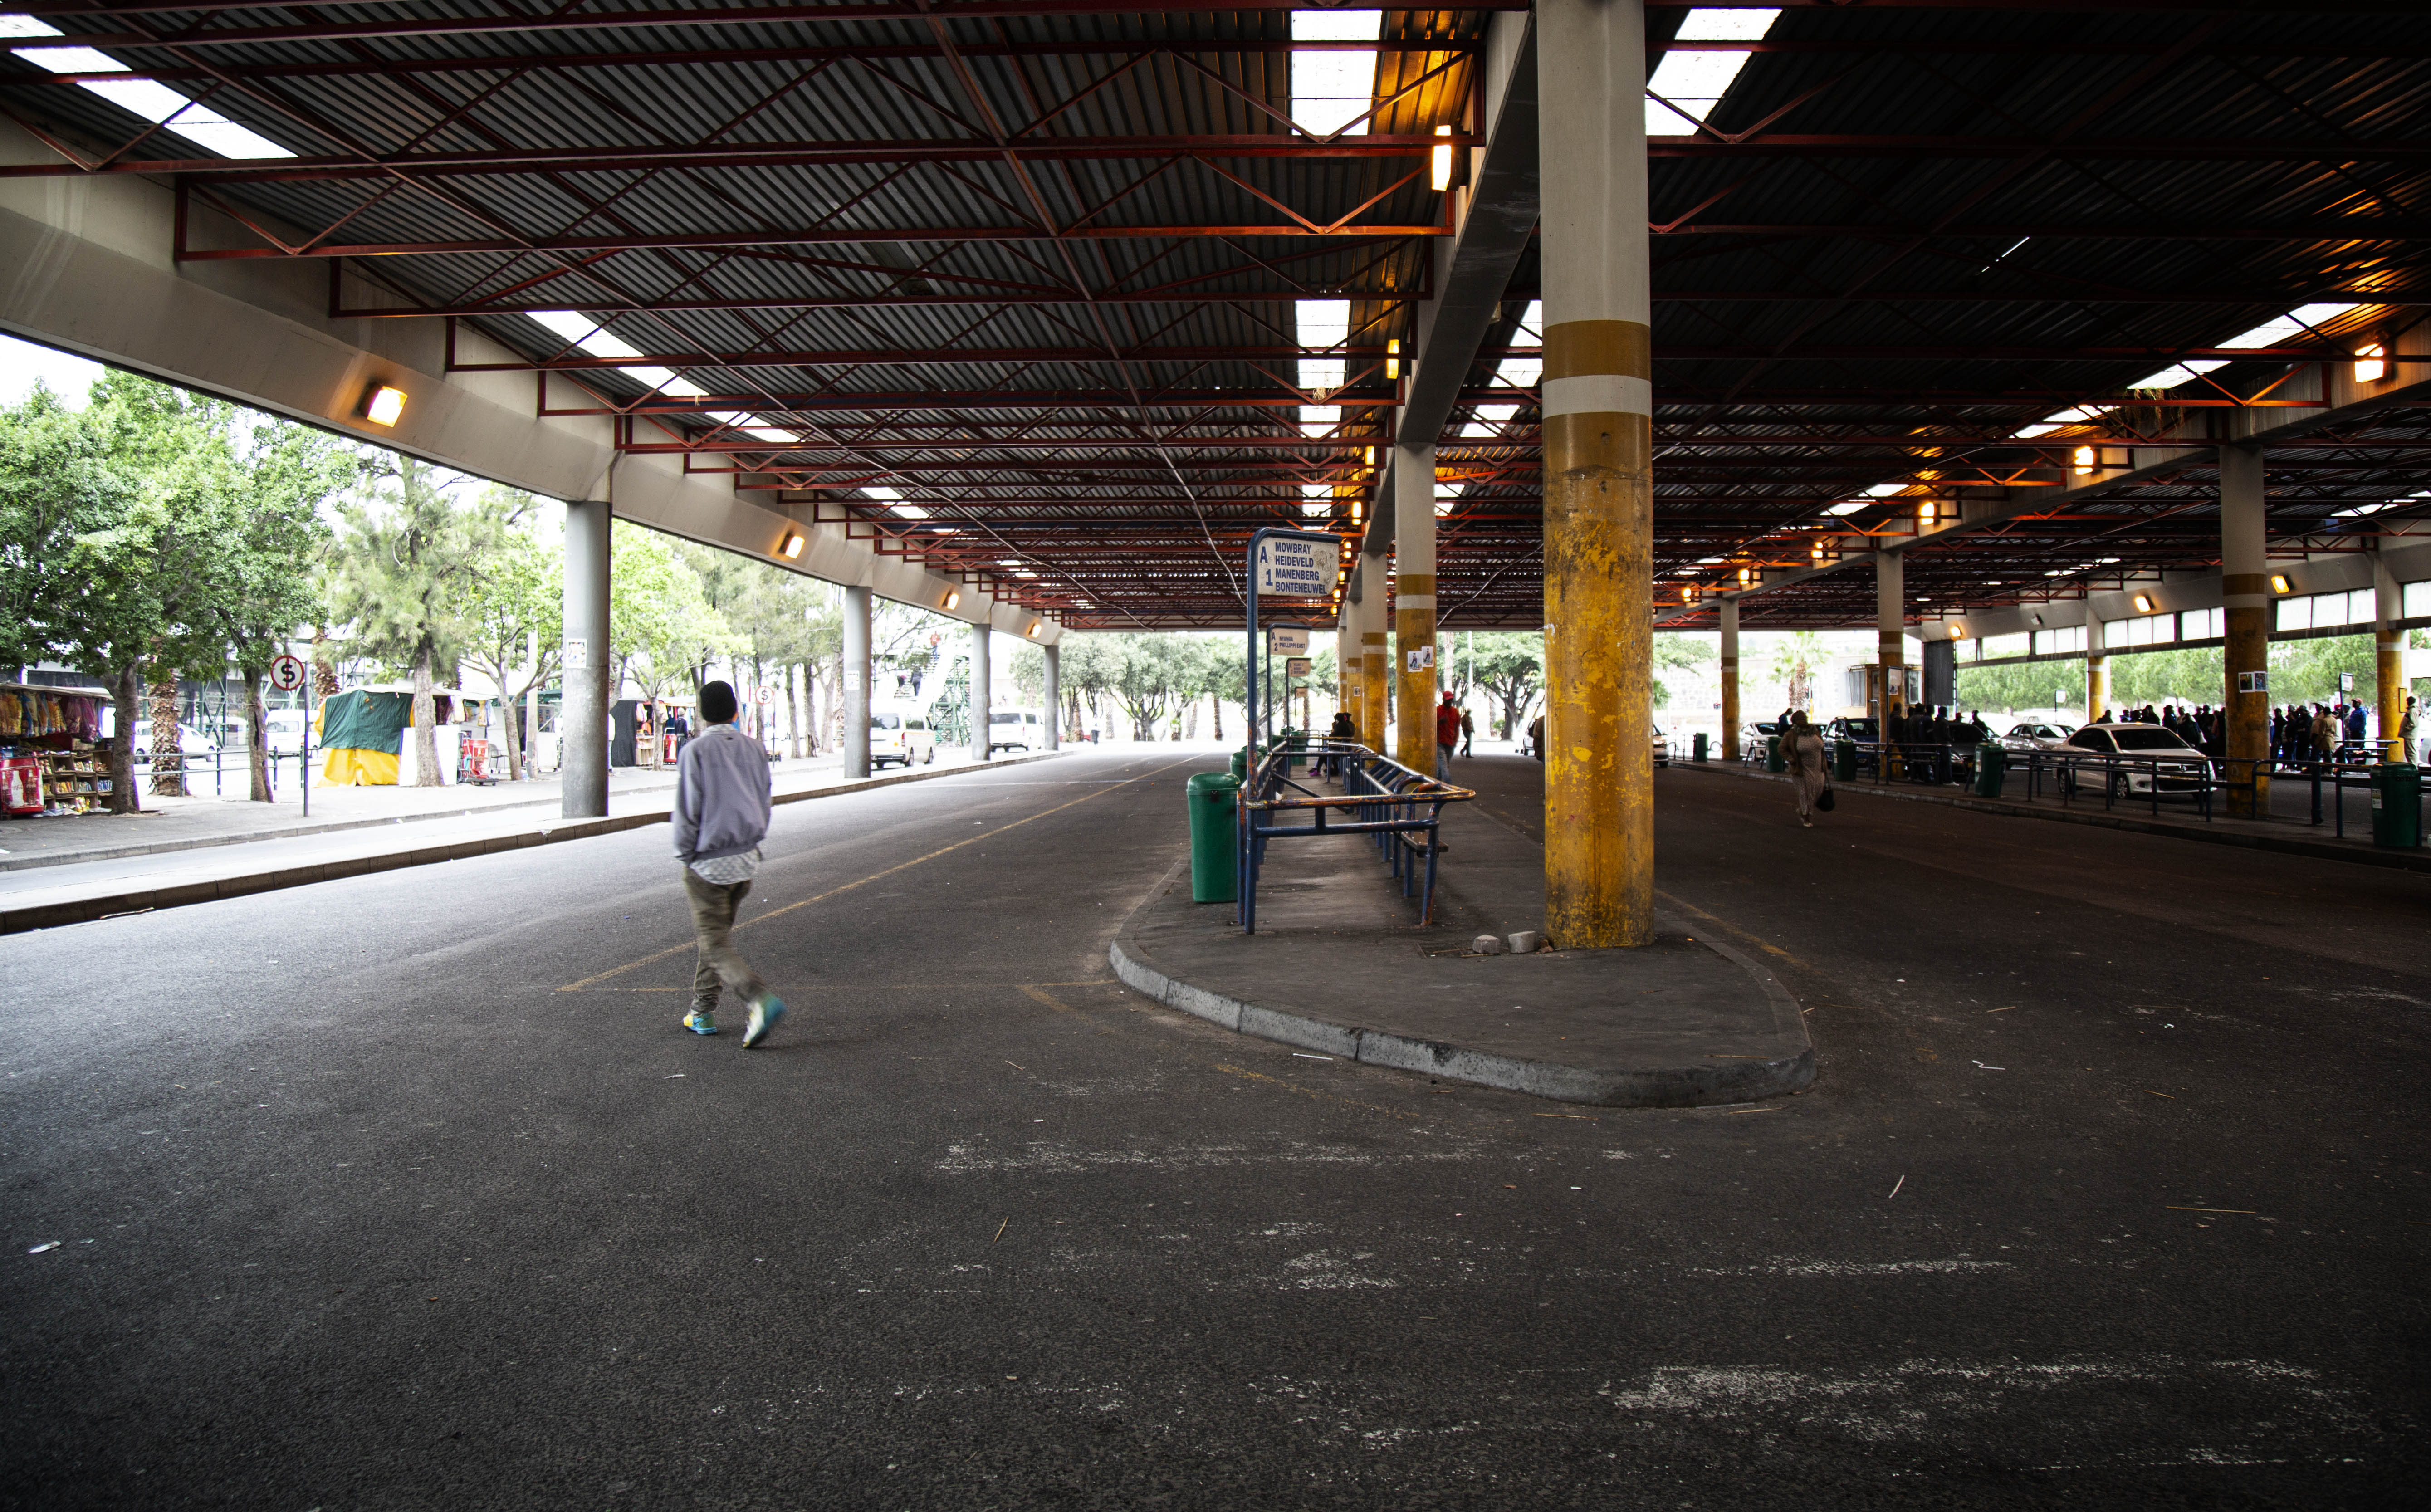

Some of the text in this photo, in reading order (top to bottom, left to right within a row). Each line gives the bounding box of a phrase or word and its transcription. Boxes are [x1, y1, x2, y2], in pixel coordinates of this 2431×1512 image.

[1275, 542, 1311, 554] MOWBRAY
[1260, 546, 1268, 563] A
[1275, 555, 1314, 568] HEIDEVELD
[1266, 569, 1273, 586] 1
[1275, 568, 1320, 581] MANENBERG
[1276, 582, 1327, 594] BONTEHEUWEL
[1272, 632, 1275, 640] A
[1274, 643, 1278, 651] 2
